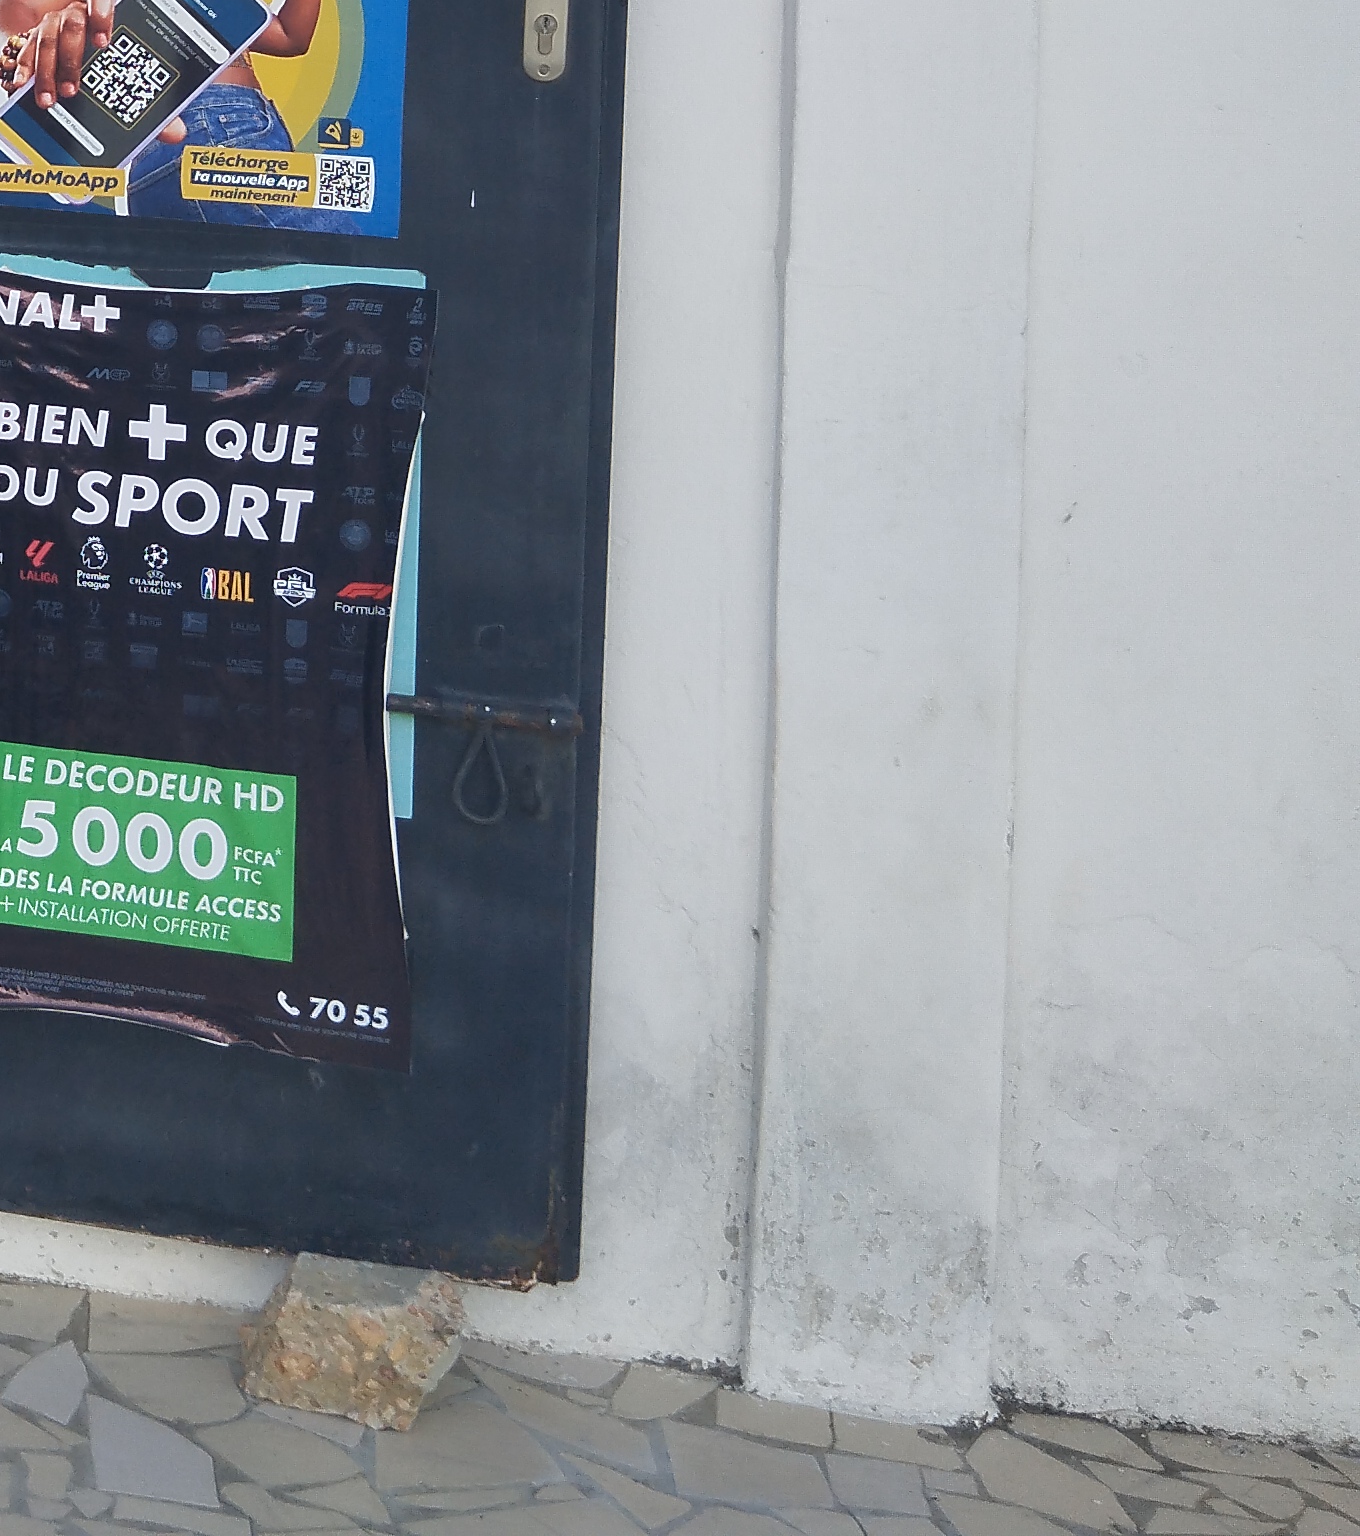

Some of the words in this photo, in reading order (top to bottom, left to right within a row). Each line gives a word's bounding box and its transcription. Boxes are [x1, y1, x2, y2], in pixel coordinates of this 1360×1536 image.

[190, 151, 289, 173] Télécharge
[212, 171, 276, 187] nouvelle
[276, 175, 308, 191] App
[210, 187, 298, 204] maintenant
[204, 418, 319, 467] QUE
[71, 469, 315, 544] SPORT
[19, 568, 59, 585] LALIGA
[76, 569, 111, 581] Premier
[76, 578, 111, 591] League
[129, 576, 183, 590] CHAMPIONS
[138, 584, 174, 597] LEAGUE
[217, 569, 255, 603] BAL
[334, 601, 386, 617] Formula
[2, 753, 35, 784] LE
[233, 781, 285, 813] HD
[0, 838, 13, 854] A
[16, 799, 59, 858] 5
[72, 805, 228, 881] 000
[233, 865, 263, 886] TTC
[0, 867, 40, 890] DES
[46, 872, 74, 897] LA
[80, 877, 190, 911] FORMULE
[194, 893, 282, 923] ACCESS
[17, 896, 147, 930] INSTALLATION
[153, 915, 231, 942] OFFERTE
[308, 995, 347, 1024] 70
[354, 1005, 390, 1030] 55
